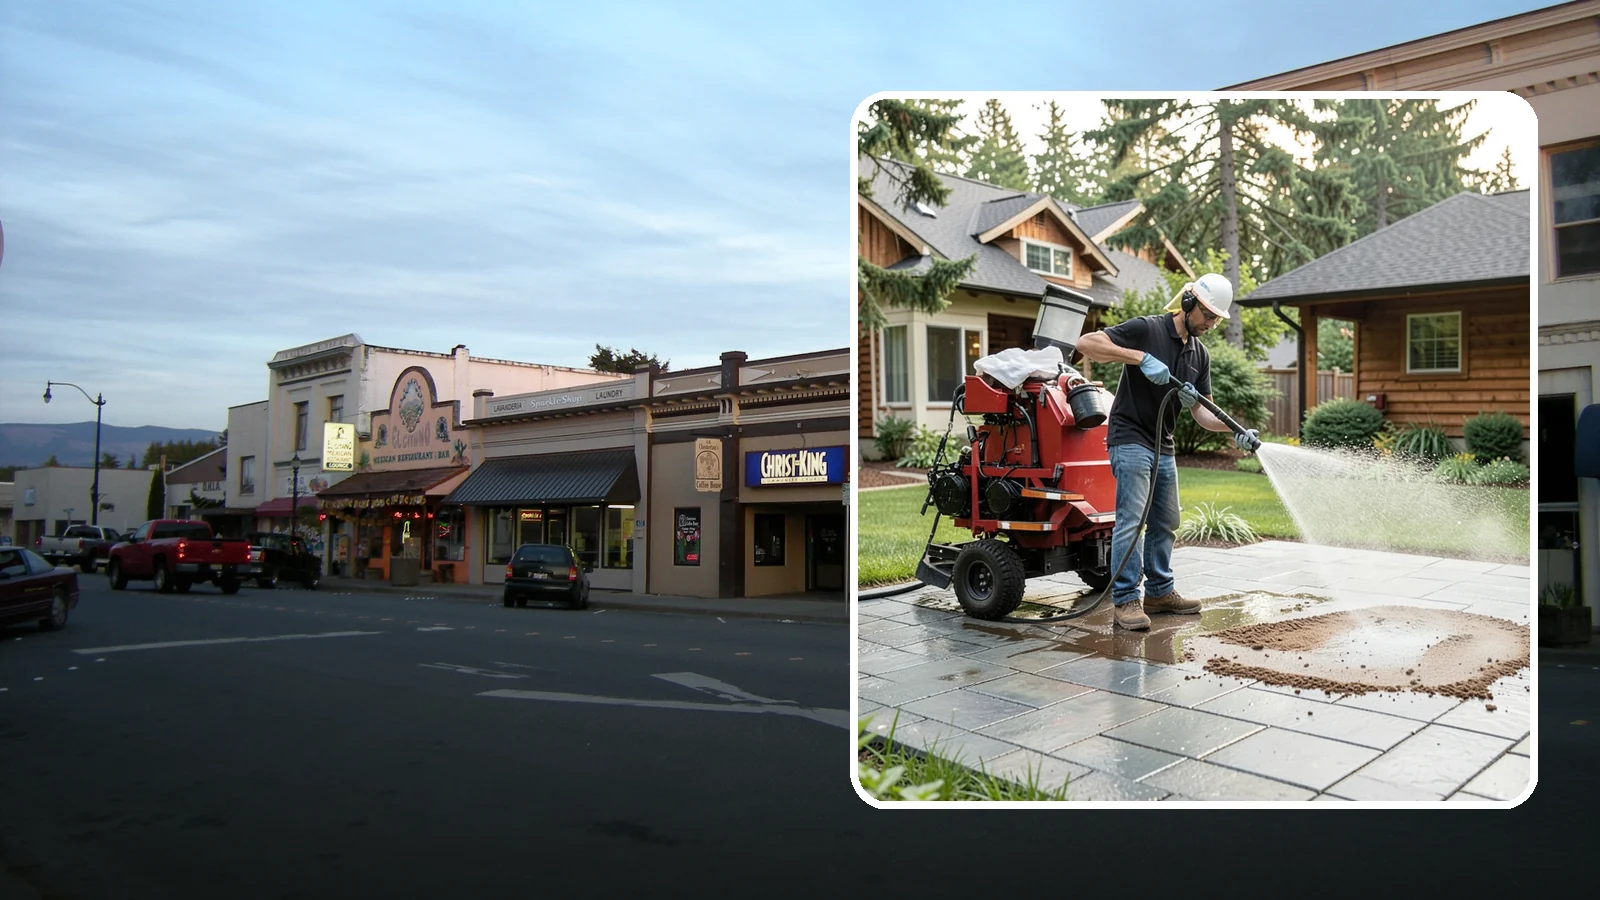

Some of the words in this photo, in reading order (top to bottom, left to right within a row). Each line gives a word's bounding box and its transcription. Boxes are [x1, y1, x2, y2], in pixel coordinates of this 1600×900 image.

[595, 388, 623, 400] LAUNDRY
[493, 402, 523, 412] LAVANDERIA
[530, 395, 561, 409] Sparkle
[561, 394, 582, 405] Shop
[373, 455, 396, 464] MEXICAN
[397, 452, 434, 462] RESTAURANT
[437, 450, 450, 459] BAR
[761, 452, 797, 478] CHRIST
[799, 450, 828, 477] KING
